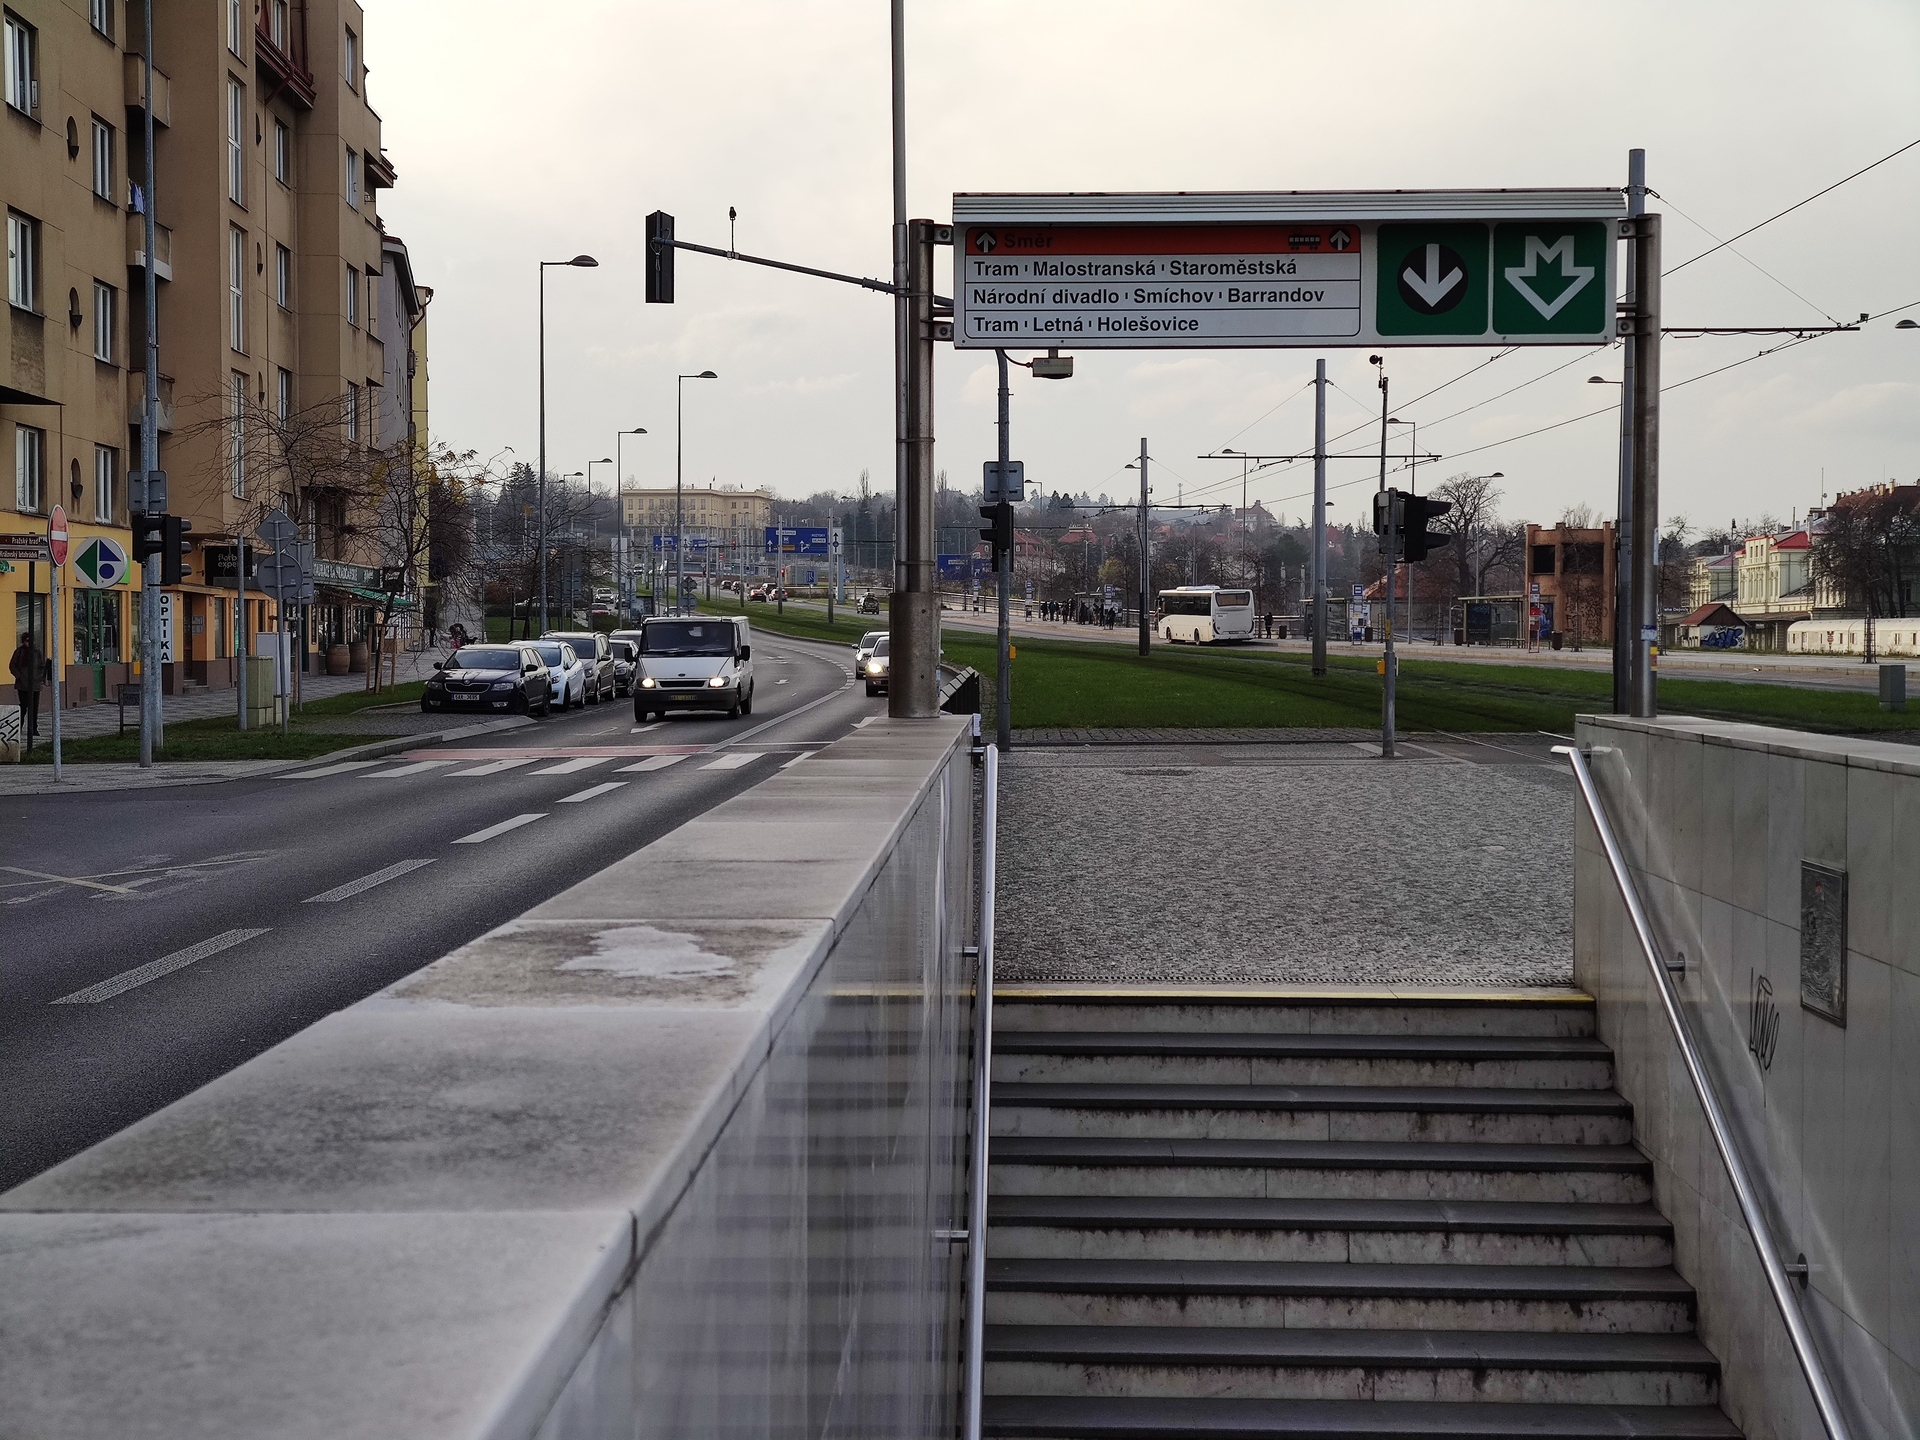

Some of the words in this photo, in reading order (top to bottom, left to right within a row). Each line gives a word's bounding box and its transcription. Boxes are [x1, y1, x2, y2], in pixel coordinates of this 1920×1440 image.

[1004, 233, 1053, 249] Směr
[973, 261, 1019, 277] Tram
[1033, 259, 1156, 277] Malostranská
[1169, 258, 1297, 276] Staroměstská
[973, 288, 1046, 304] Národní
[1052, 288, 1120, 304] divadlo
[1133, 287, 1214, 304] Smíchov
[1227, 287, 1325, 303] Barrandov
[973, 317, 1019, 332] Tram
[1033, 315, 1084, 332] Letná
[1097, 315, 1199, 332] Holešovice
[160, 595, 170, 661] OPTIKA
